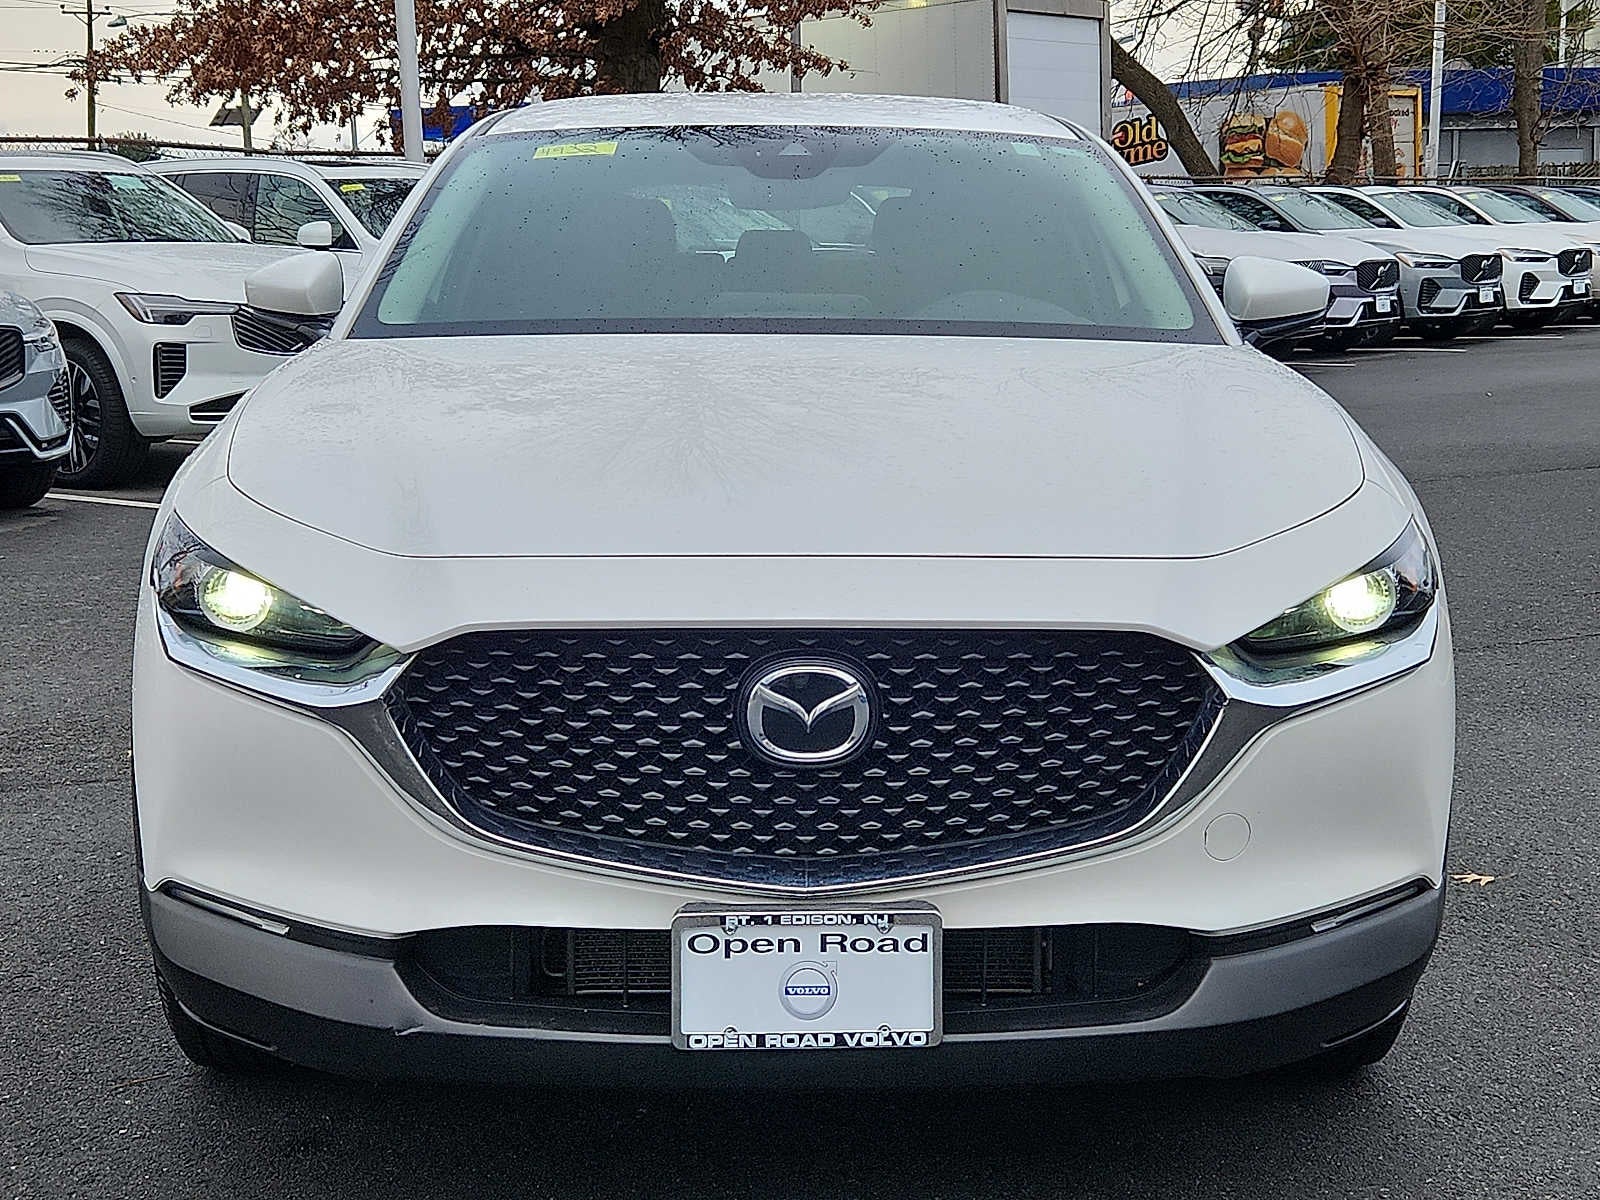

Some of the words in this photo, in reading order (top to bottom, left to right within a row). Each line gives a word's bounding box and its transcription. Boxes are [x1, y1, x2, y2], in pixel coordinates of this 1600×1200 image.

[1114, 116, 1158, 147] Old
[725, 915, 753, 926] RT.
[763, 916, 771, 926] 1
[780, 915, 855, 926] EDISON,
[863, 914, 888, 925] NJ
[687, 933, 801, 959] Open
[820, 933, 929, 953] Road
[787, 987, 829, 995] VOLVO
[688, 1033, 756, 1048] OPEN
[765, 1033, 834, 1047] ROAD
[842, 1031, 927, 1046] VOLVO
